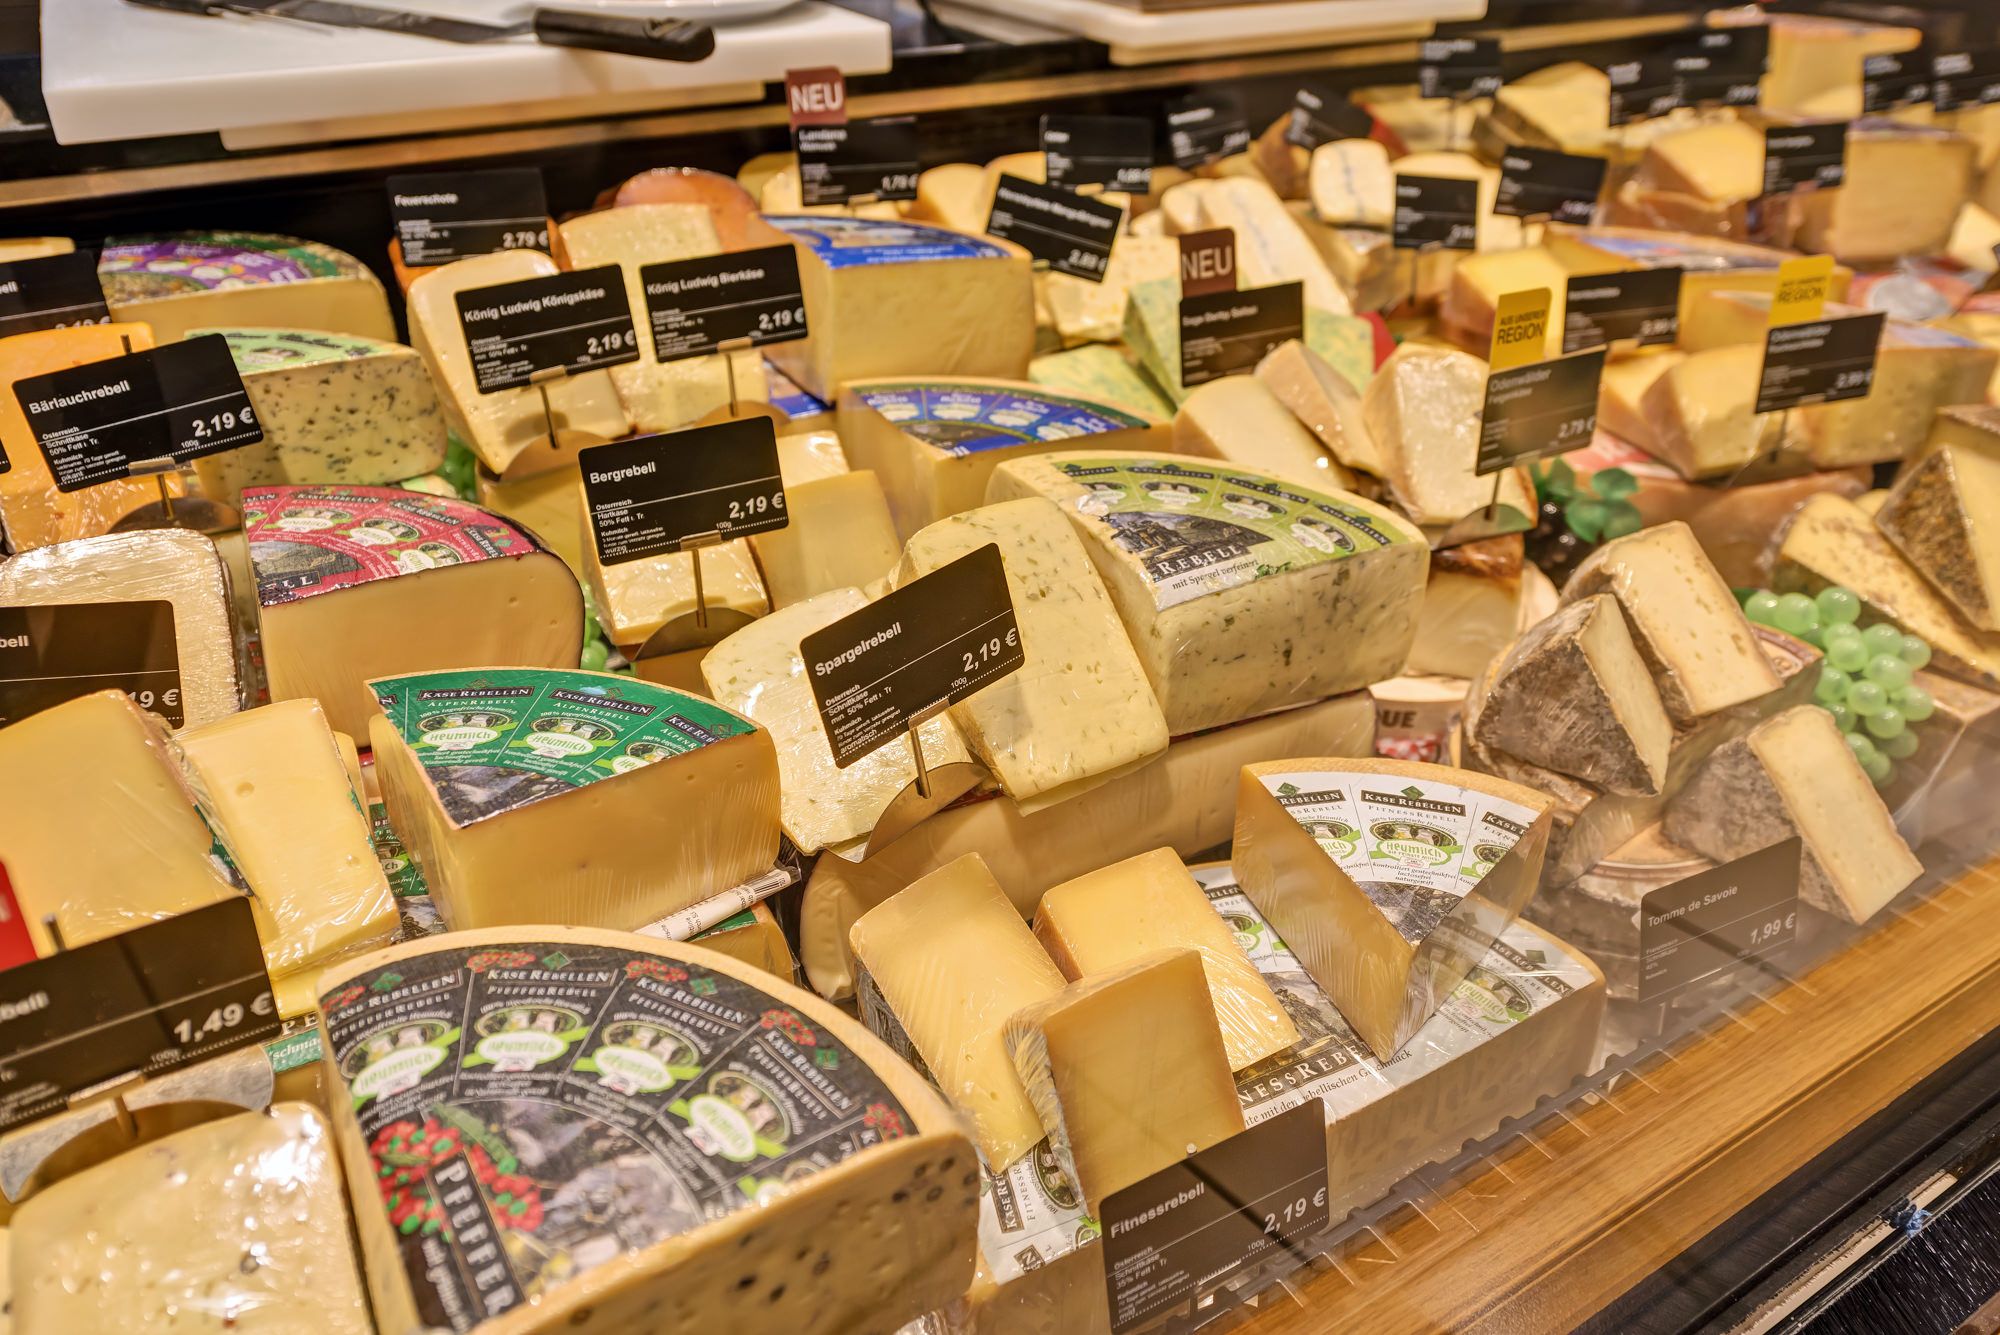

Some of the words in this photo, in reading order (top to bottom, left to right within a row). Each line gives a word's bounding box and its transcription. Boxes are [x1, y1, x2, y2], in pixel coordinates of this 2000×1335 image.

[790, 82, 844, 113] NEU
[1182, 245, 1233, 281] NEU
[647, 281, 679, 295] König
[680, 274, 718, 289] Ludwig
[464, 307, 498, 323] König
[499, 300, 542, 317] Ludwig
[758, 309, 793, 330] 2,19
[587, 332, 623, 355] 2,19
[624, 330, 636, 346] €
[1496, 321, 1545, 345] REGION
[29, 380, 130, 415] Bärlauchrebell
[192, 411, 236, 437] 2,19
[239, 407, 254, 424] €
[181, 439, 199, 450] 100g
[590, 462, 656, 484] Bergrebell
[729, 496, 767, 519] 2,19
[771, 492, 783, 509] €
[599, 519, 615, 527] 50%
[716, 521, 731, 529] 100g
[1172, 579, 1188, 590] mit
[815, 622, 902, 676] Spargelrebell
[962, 638, 1001, 672] 2,19
[1005, 627, 1017, 647] €
[951, 676, 968, 689] 100g
[162, 688, 179, 707] €
[847, 704, 863, 716] 50%
[864, 695, 878, 706] Fett
[834, 716, 862, 735] Kuhmilch
[841, 729, 877, 754] aromatisch
[1279, 793, 1340, 805] REBELLEN
[1399, 799, 1461, 813] REBELLEN
[1368, 805, 1457, 823] FITNESSREBELL
[1386, 842, 1441, 858] Heumilch
[1372, 862, 1410, 872] kontrolliert
[1398, 871, 1431, 880] lactosefrei
[1648, 907, 1685, 927] Tomme
[1688, 900, 1701, 912] de
[1703, 886, 1738, 906] Savoie
[1750, 920, 1781, 944] 1,99
[1785, 913, 1795, 928] €
[530, 970, 611, 982] REBELLEN
[173, 1002, 244, 1043] 1,49
[250, 992, 272, 1016] €
[672, 989, 746, 1024] REBELLEN
[791, 1053, 853, 1110] REBELLEN
[1261, 1104, 1279, 1119] mit
[1110, 1181, 1205, 1238] Fitnessrebell
[1263, 1198, 1307, 1234] 2,19
[1313, 1187, 1326, 1207] €
[434, 1159, 516, 1317] PFEFFER
[1247, 1238, 1265, 1251] 100g
